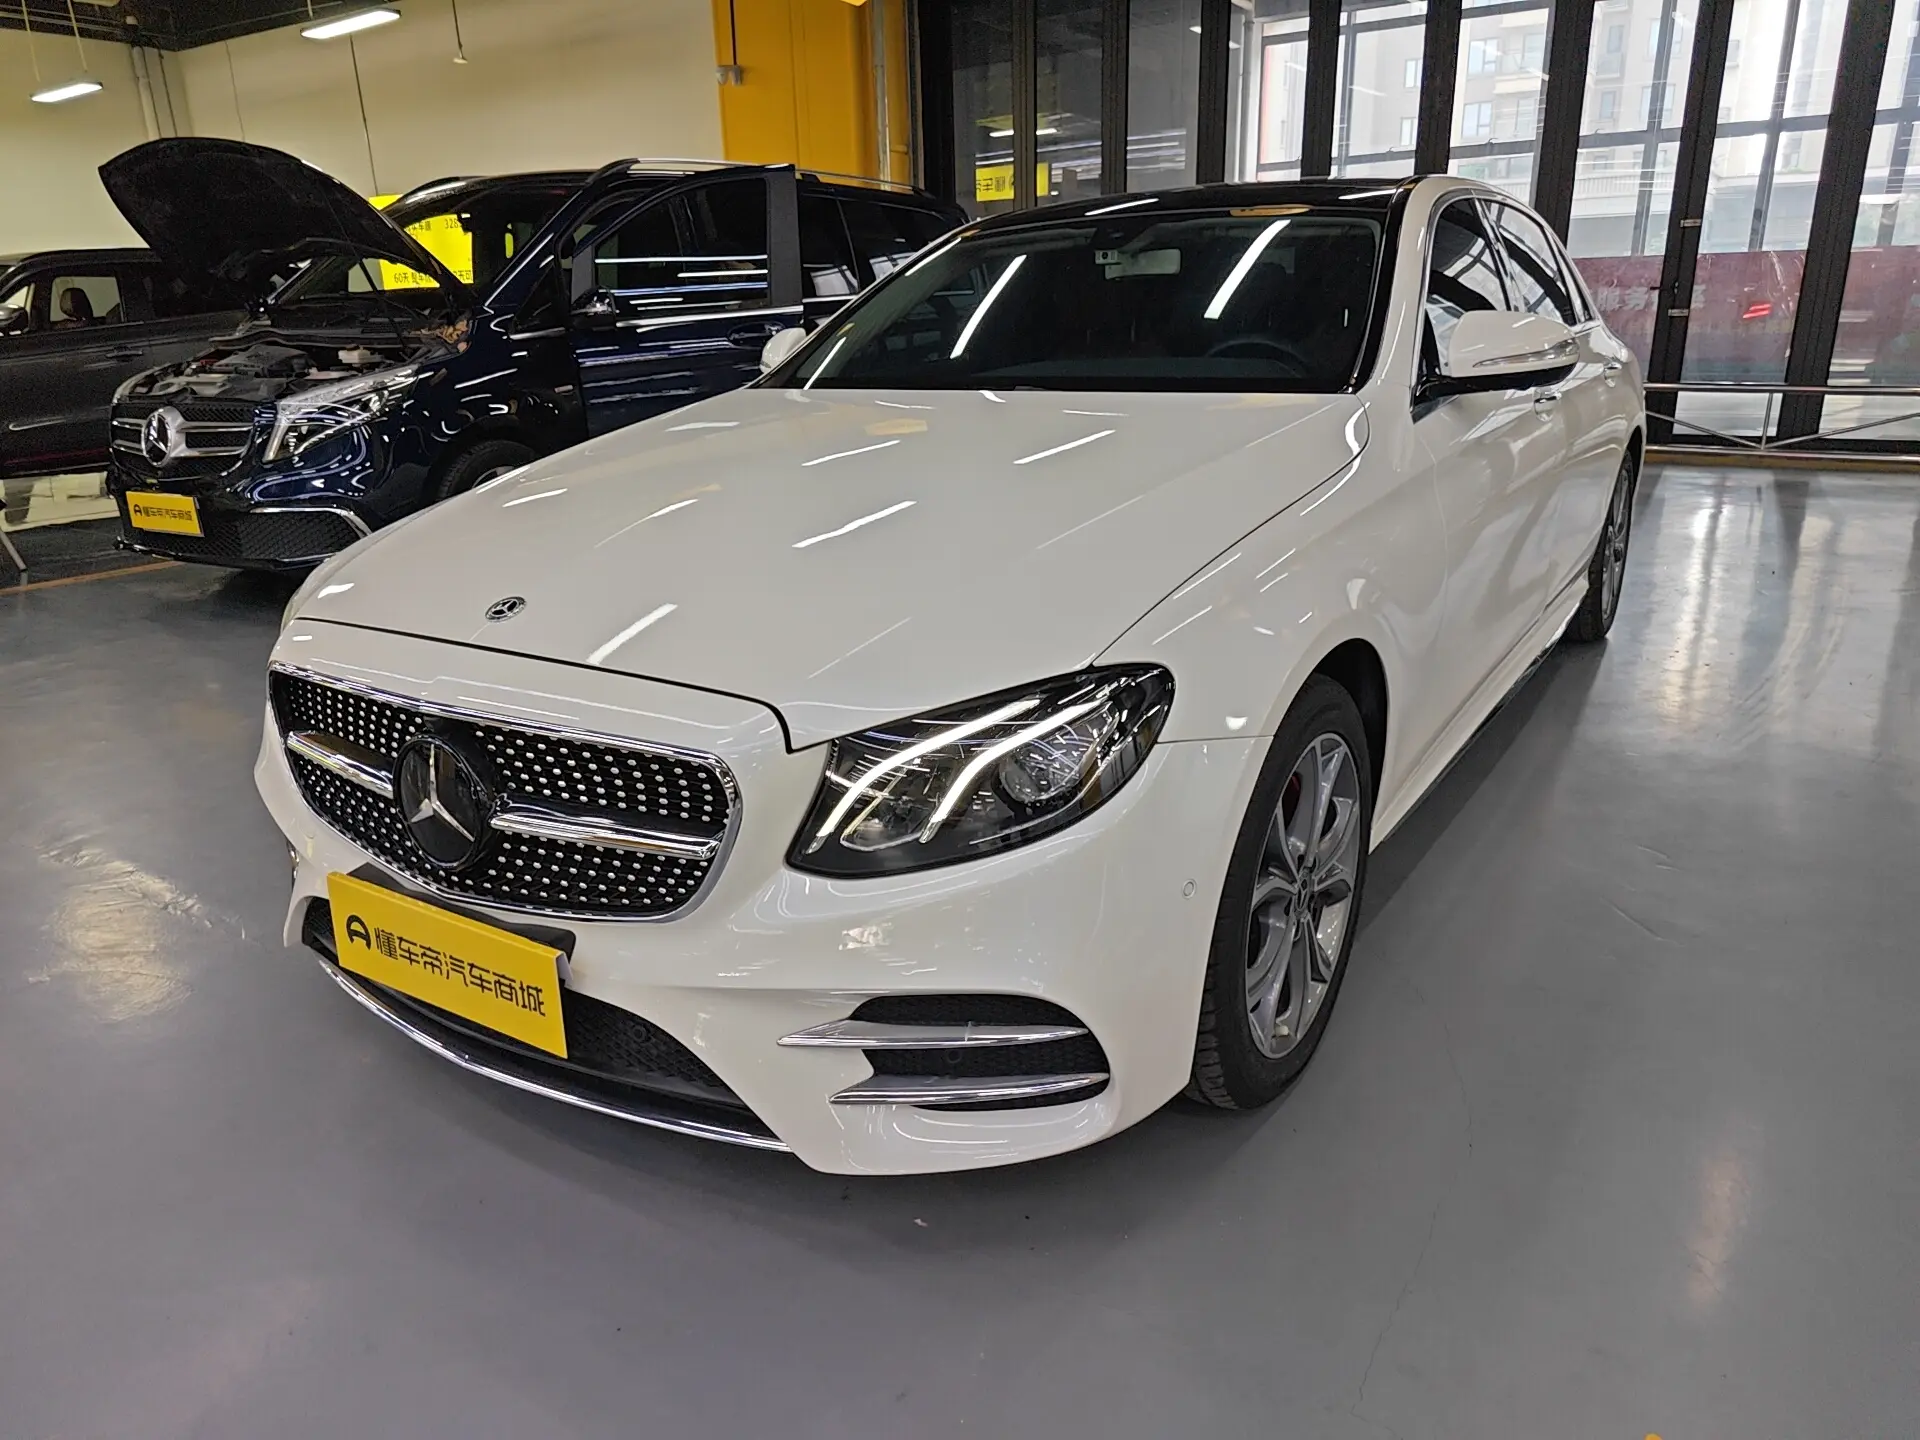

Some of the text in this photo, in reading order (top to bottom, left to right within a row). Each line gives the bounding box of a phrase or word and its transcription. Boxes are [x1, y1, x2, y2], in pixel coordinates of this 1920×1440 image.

[374, 927, 546, 1016] 懂车帝汽车商城
